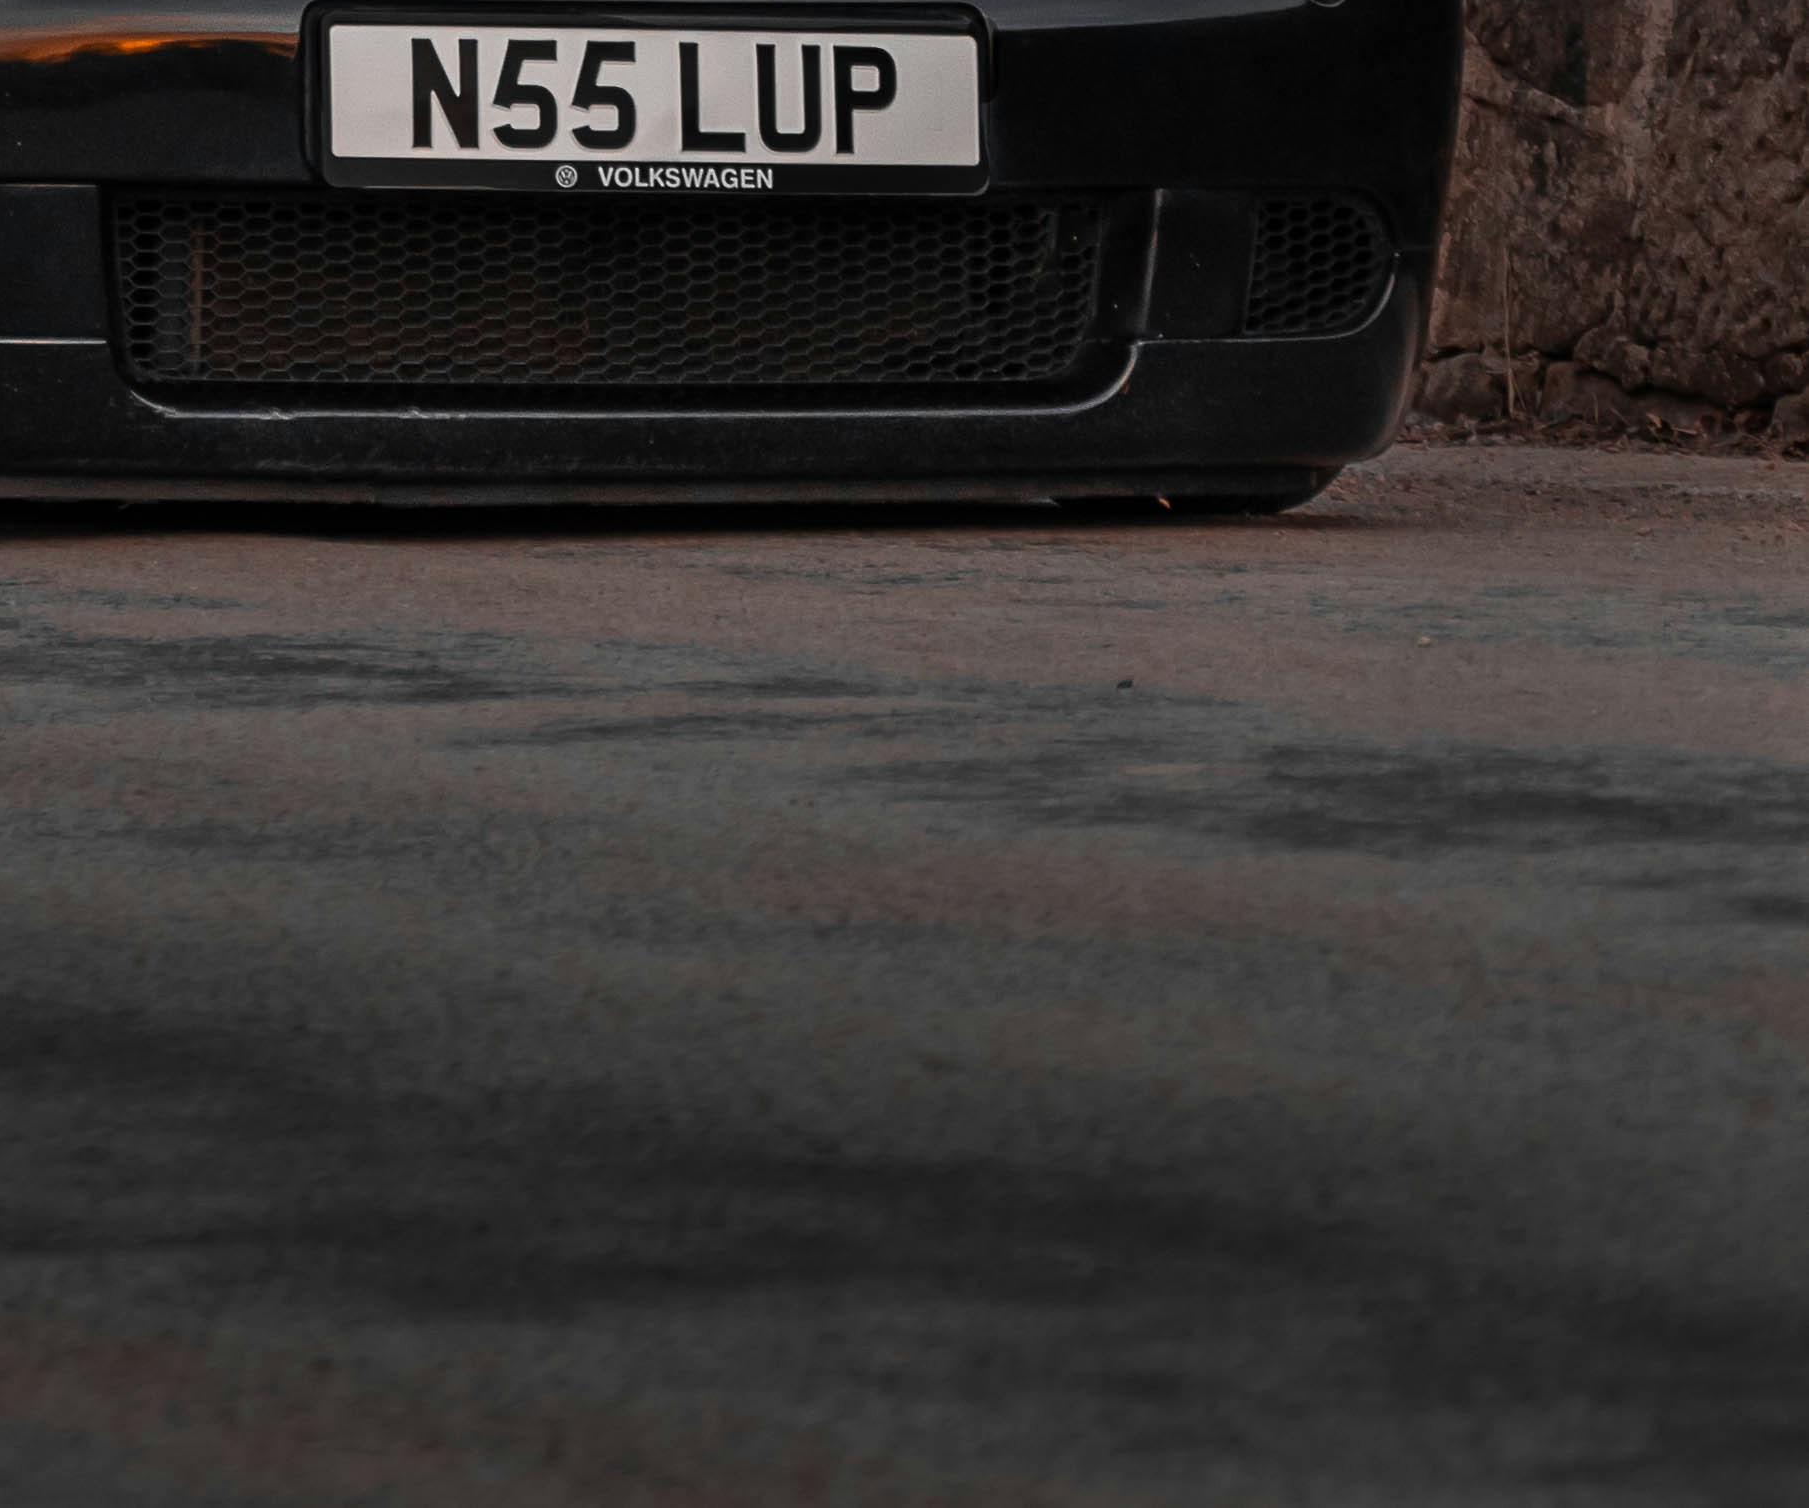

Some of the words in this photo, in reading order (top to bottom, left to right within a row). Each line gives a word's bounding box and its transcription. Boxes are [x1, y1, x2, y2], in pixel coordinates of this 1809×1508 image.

[411, 37, 637, 150] N55
[678, 41, 898, 155] LUP
[597, 166, 774, 189] VOLKSWAGEN
